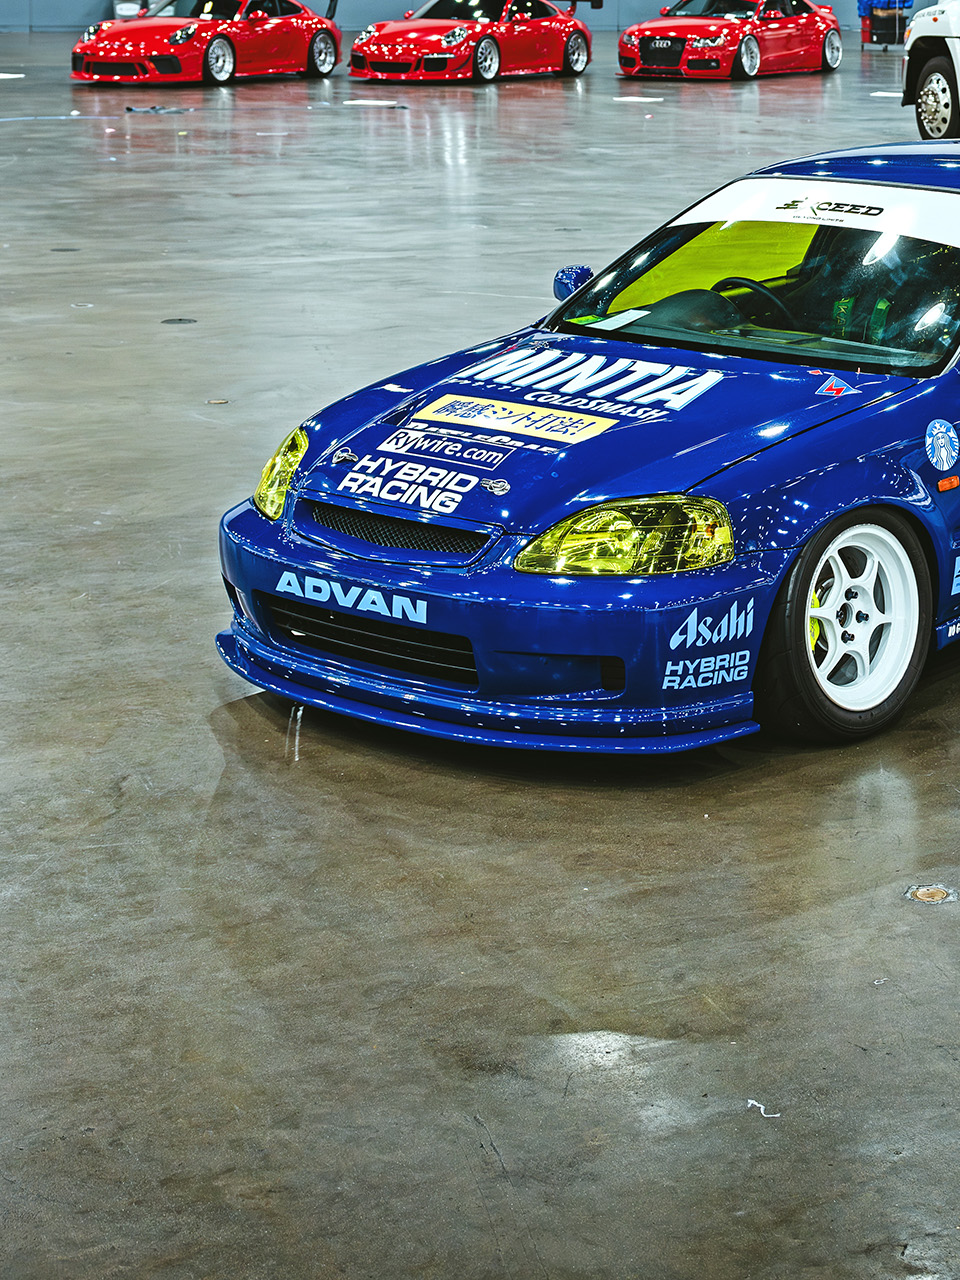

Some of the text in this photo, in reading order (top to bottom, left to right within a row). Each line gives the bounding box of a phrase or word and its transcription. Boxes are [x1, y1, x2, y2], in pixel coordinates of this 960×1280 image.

[453, 348, 725, 412] MINTIA
[523, 391, 670, 420] COLDSMASH
[386, 430, 504, 465] Rywire.com
[337, 472, 463, 514] RACING
[352, 454, 480, 493] HYBRID
[275, 570, 428, 624] ADVAN
[669, 597, 755, 650] Asahi
[661, 665, 749, 690] RACING
[664, 650, 751, 675] HYBRID
